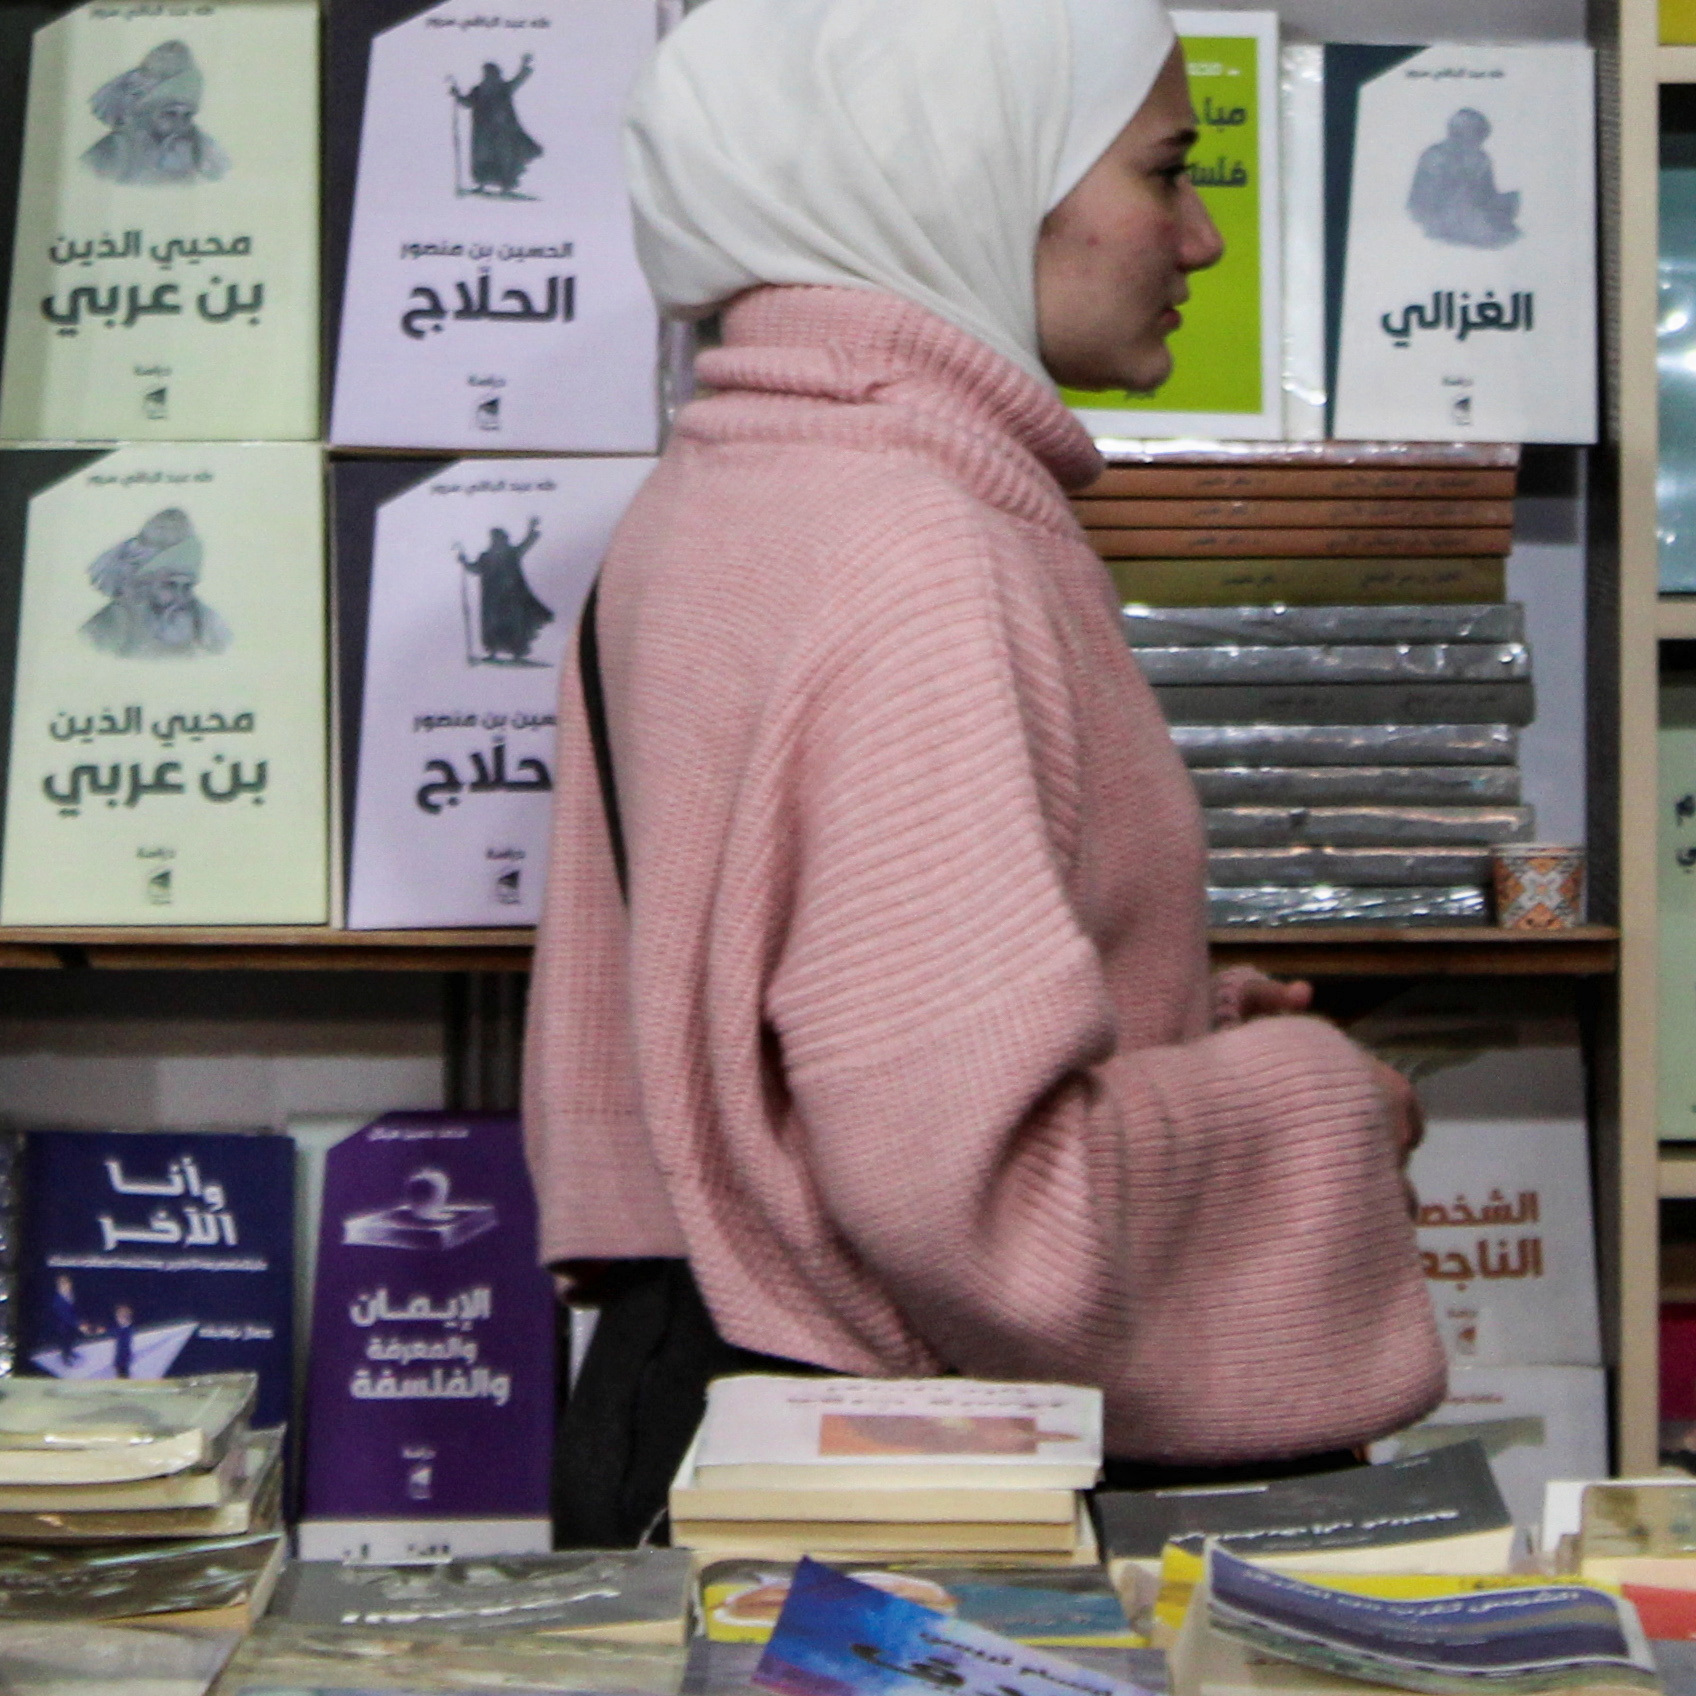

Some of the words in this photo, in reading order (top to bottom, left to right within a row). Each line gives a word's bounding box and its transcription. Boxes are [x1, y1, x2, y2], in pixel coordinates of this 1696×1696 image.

[50, 229, 143, 262] الدين
[152, 232, 252, 270] محيي
[400, 243, 463, 261] منصور
[467, 243, 495, 261] بن
[498, 242, 574, 264] الحسين
[41, 279, 182, 336] عربي
[195, 276, 265, 324] بن
[1381, 290, 1534, 347] الغزالي
[49, 706, 142, 742] الدين
[151, 711, 255, 748] محيي
[42, 758, 184, 817] عربي
[199, 753, 267, 804] بن
[1417, 1189, 1541, 1231] الشخص
[350, 1287, 492, 1331] الإيمان
[366, 1336, 479, 1363] والمعرفة
[350, 1370, 511, 1407] والفلسفة
